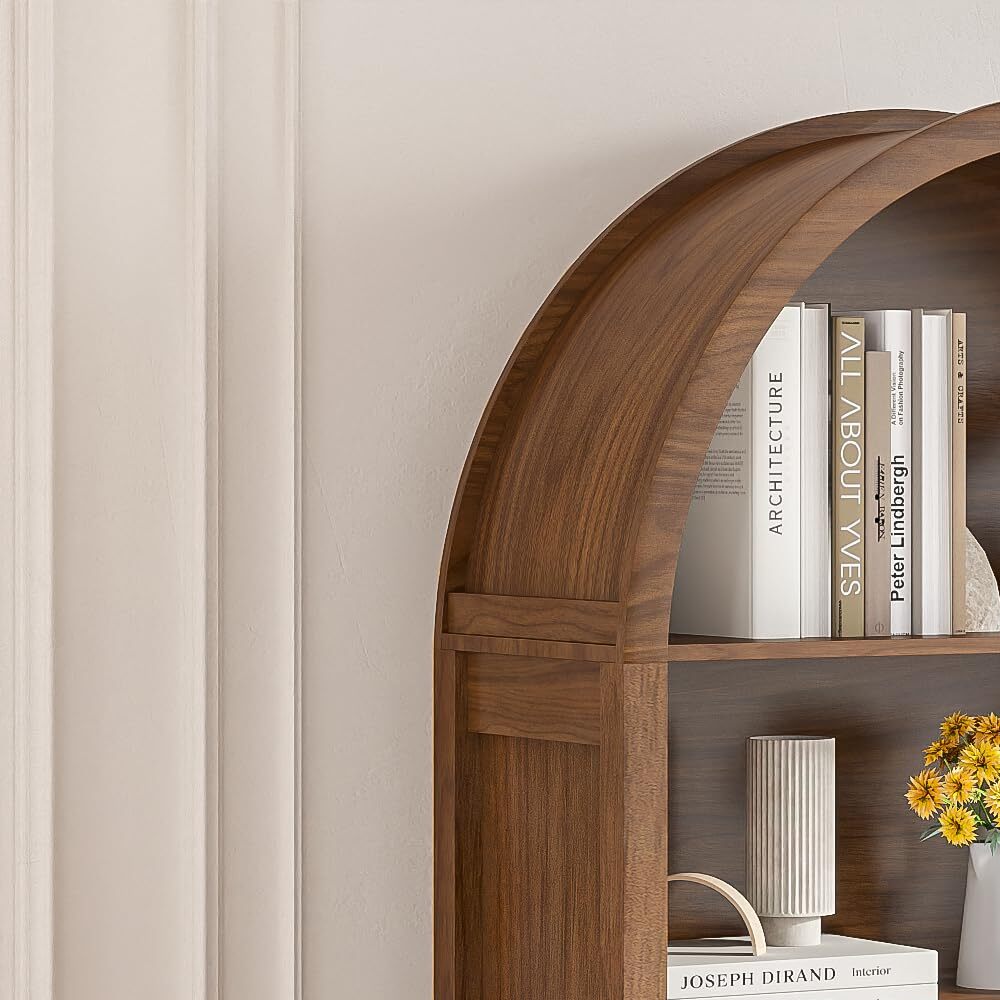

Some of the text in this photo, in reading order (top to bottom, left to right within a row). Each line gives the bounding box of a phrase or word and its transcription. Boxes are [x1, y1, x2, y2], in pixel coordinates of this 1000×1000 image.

[840, 331, 862, 386] ALL
[897, 350, 905, 390] Photography
[897, 417, 904, 426] on
[768, 371, 784, 535] ARCHITECTURE
[840, 397, 862, 504] ABOUT
[890, 454, 909, 602] Peter Lindbergh
[840, 518, 861, 596] YVES
[681, 967, 836, 990] JOSEPH DIRAND
[852, 965, 892, 977] Interior
